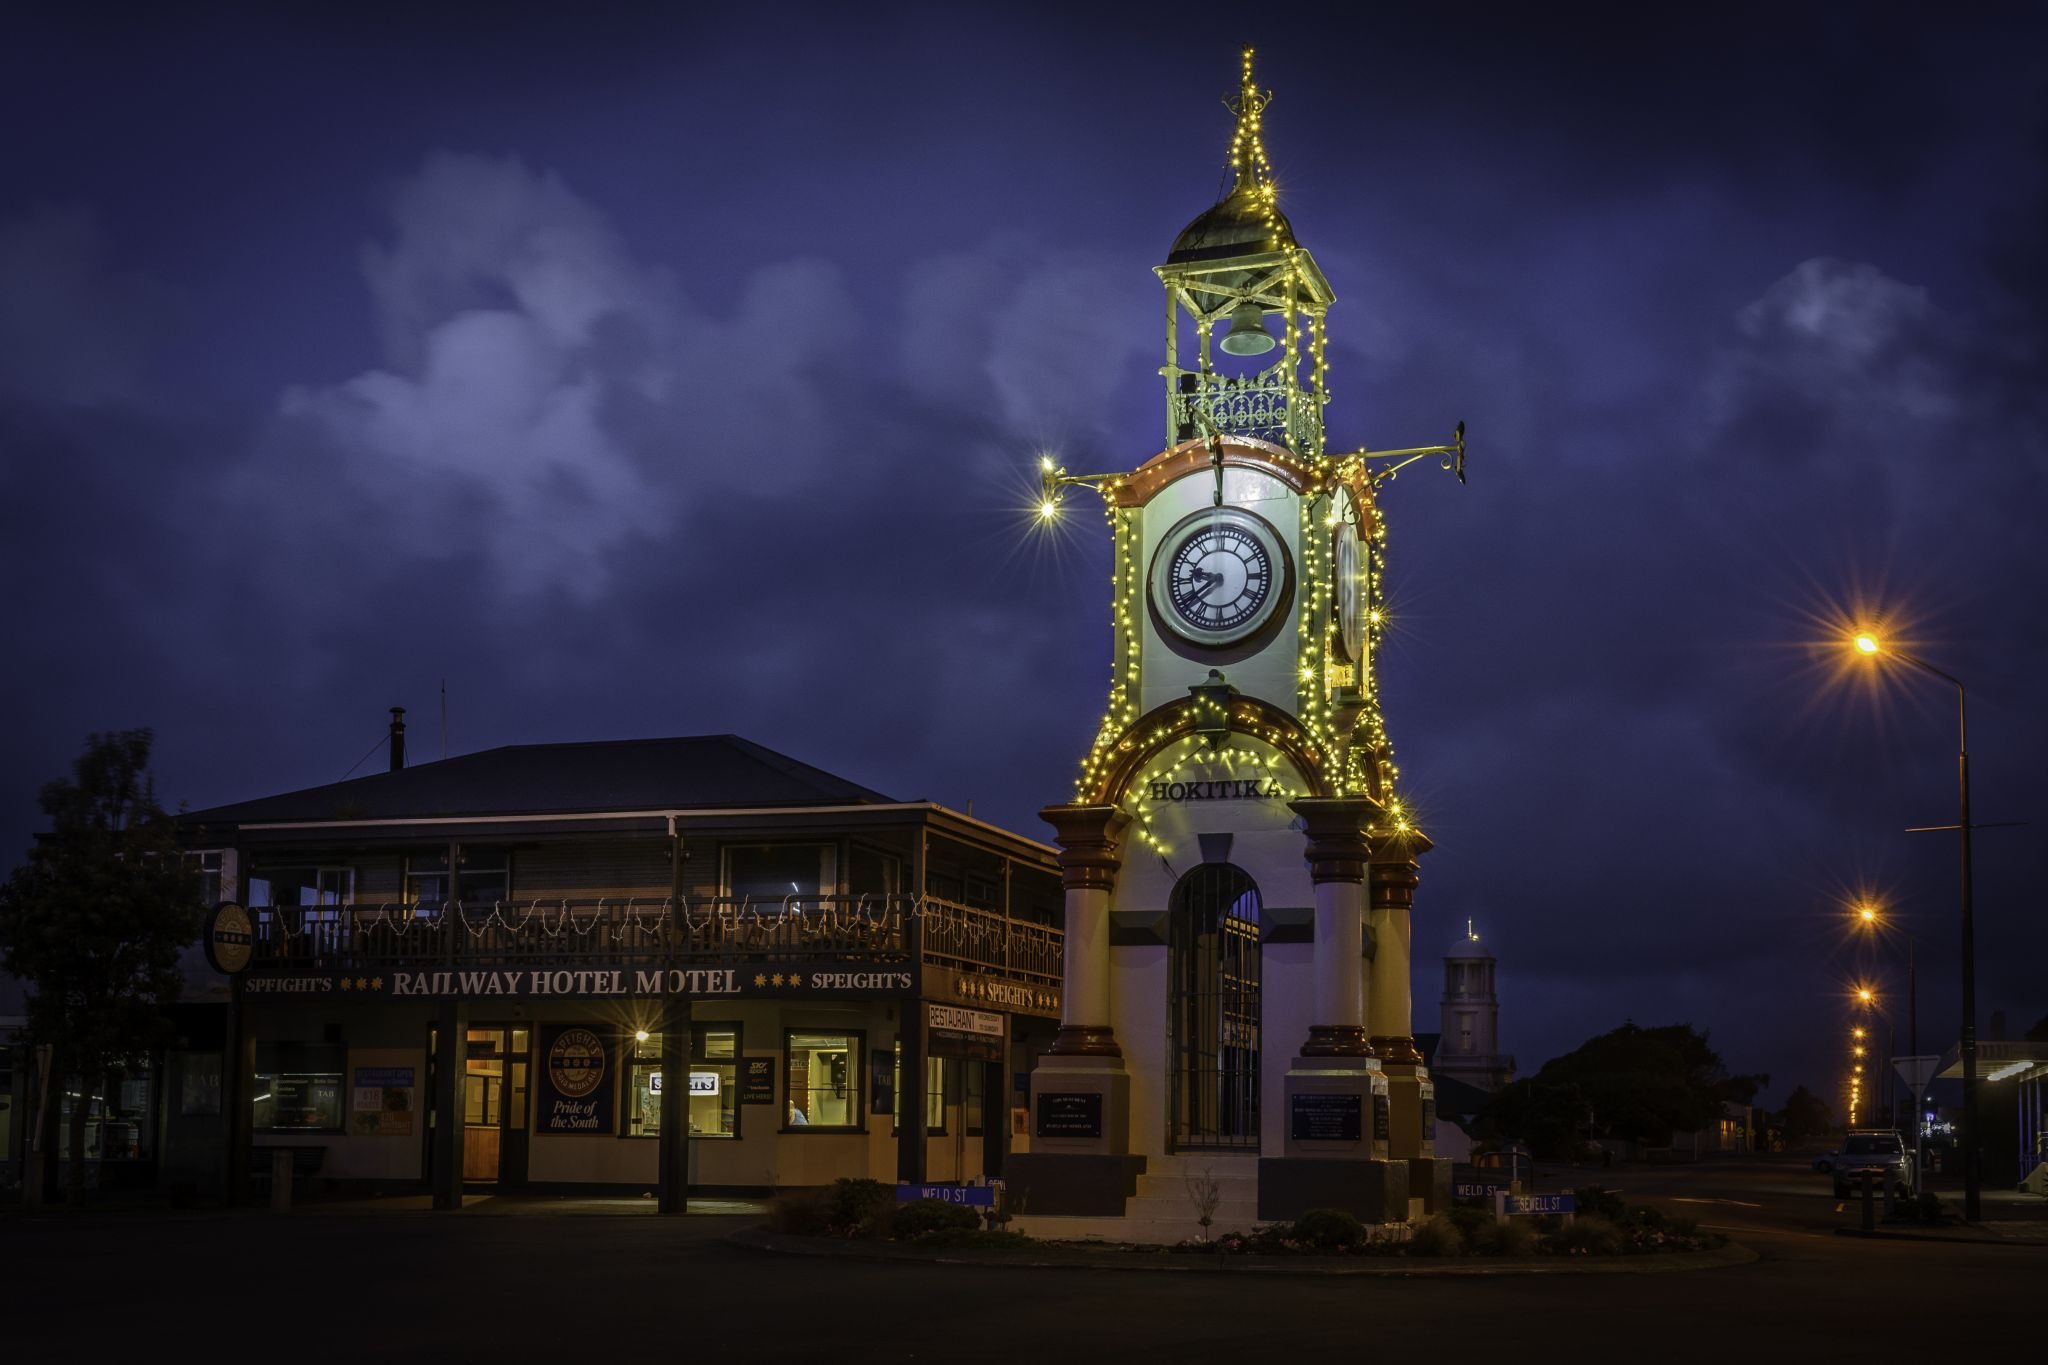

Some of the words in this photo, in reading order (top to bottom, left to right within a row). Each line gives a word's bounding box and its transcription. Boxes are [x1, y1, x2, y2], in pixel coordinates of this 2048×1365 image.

[1150, 779, 1281, 801] HOKITIKA
[392, 972, 522, 995] RAILWAY
[529, 971, 627, 994] HOTEL
[635, 970, 742, 993] MOTEL
[811, 972, 912, 989] SPEIGHT'S
[988, 982, 1033, 1007] SPEIGHT'S
[930, 1007, 975, 1030] RESTAURANT
[553, 1100, 582, 1114] Pride
[583, 1100, 598, 1117] of
[550, 1116, 567, 1128] the
[567, 1115, 600, 1129] South
[921, 1187, 950, 1201] WELD
[955, 1188, 967, 1202] ST
[1457, 1185, 1482, 1196] WELD
[1487, 1184, 1497, 1196] ST
[1519, 1198, 1549, 1211] SEWELL
[1551, 1196, 1560, 1210] ST
